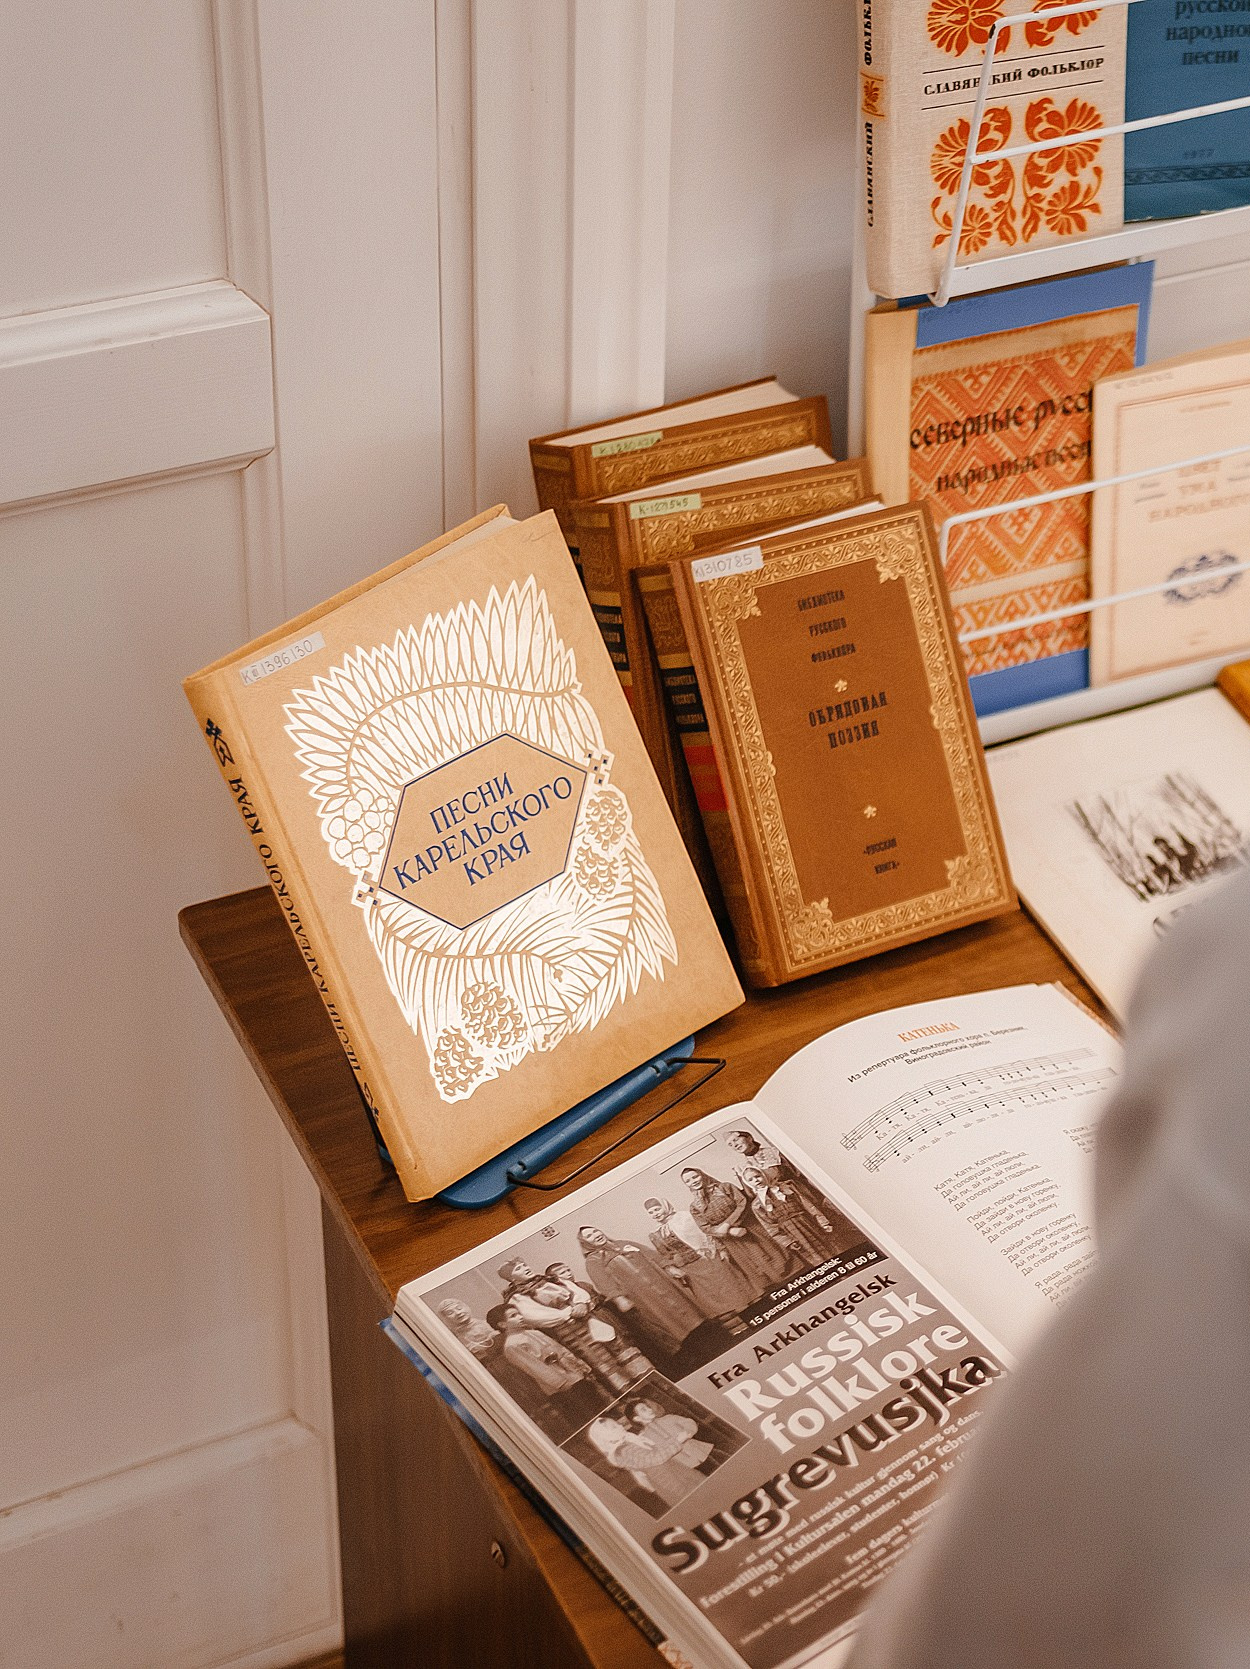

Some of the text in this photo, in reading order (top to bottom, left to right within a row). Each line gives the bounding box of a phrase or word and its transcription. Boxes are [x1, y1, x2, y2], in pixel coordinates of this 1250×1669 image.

[924, 57, 1105, 96] СЛАВЯНКИЙ ФОЛЬКЛОР
[1182, 50, 1239, 66] песни
[808, 691, 888, 727] ОБРЯДОВАЯ
[827, 720, 880, 750] ПОЭЗИЯ
[429, 771, 514, 834] ПЕСНИ
[392, 776, 573, 890] КАРЕЛЬСКОГО
[462, 831, 532, 886] КРАЯ
[228, 777, 362, 1071] ПЕСНИ КАРЕЛЬСКОГО КРАЯ
[897, 1021, 961, 1043] КАТЕНЬКА
[847, 1072, 862, 1083] Из
[862, 1051, 910, 1076] репертуара
[909, 1037, 966, 1055] фольклорного
[904, 1039, 992, 1065] Виноградовский район
[933, 1150, 1010, 1191] Катя, Катя, Катенька,
[940, 1151, 1029, 1198] Да головушка гладенька,
[947, 1194, 959, 1204] Ай
[959, 1188, 972, 1197] ли,
[971, 1181, 982, 1189] ай
[982, 1175, 995, 1183] ли,
[994, 1168, 1005, 1177] ай
[953, 1201, 966, 1211] Да
[965, 1179, 1005, 1203] головушка
[966, 1177, 1053, 1223] Пойди, пойди, Катенька,
[973, 1220, 987, 1231] Да
[986, 1207, 1008, 1222] зайди
[1014, 1194, 1032, 1206] нову
[981, 1226, 993, 1236] Ай
[993, 1220, 1006, 1229] ли,
[1005, 1213, 1015, 1221] ай
[1015, 1207, 1028, 1215] ли,
[1027, 1200, 1037, 1209] ай
[987, 1233, 1000, 1244] Да
[999, 1217, 1026, 1235] отвори
[1000, 1238, 1026, 1256] Зайди
[1031, 1225, 1049, 1237] нову
[1007, 1253, 1020, 1263] Да
[1019, 1237, 1045, 1255] отвори
[1015, 1260, 1026, 1269] Ай
[1026, 1253, 1039, 1261] ли,
[1038, 1246, 1049, 1254] ай
[1061, 1233, 1071, 1242] ай
[770, 1257, 843, 1301] Fra Arkhangelsk:
[1021, 1266, 1034, 1277] Да
[1033, 1250, 1060, 1268] отвори
[1034, 1281, 1043, 1289] Я
[1042, 1270, 1065, 1285] рада,
[1063, 1259, 1082, 1271] рада
[749, 1316, 764, 1327] 15
[763, 1292, 801, 1321] personer
[806, 1271, 839, 1293] alderen
[837, 1266, 847, 1275] 8
[845, 1260, 856, 1271] til
[854, 1255, 868, 1266] 60
[866, 1250, 879, 1261] år
[1041, 1286, 1054, 1296] Да
[1053, 1275, 1073, 1288] рада
[706, 1271, 899, 1390] Fra Arkhangelsk
[722, 1291, 938, 1423] Russisk
[760, 1324, 970, 1455] folklore
[650, 1354, 1006, 1575] Sugrevusjka
[809, 1495, 846, 1523] russisk
[843, 1475, 877, 1500] kultur
[875, 1448, 919, 1481] gjennom
[917, 1432, 945, 1452] sang
[943, 1423, 959, 1438] og
[956, 1409, 985, 1428] dans.
[782, 1503, 861, 1556] Kultursalen
[860, 1469, 916, 1507] mandag
[912, 1454, 937, 1474] 22.
[848, 1498, 902, 1534] studenter,
